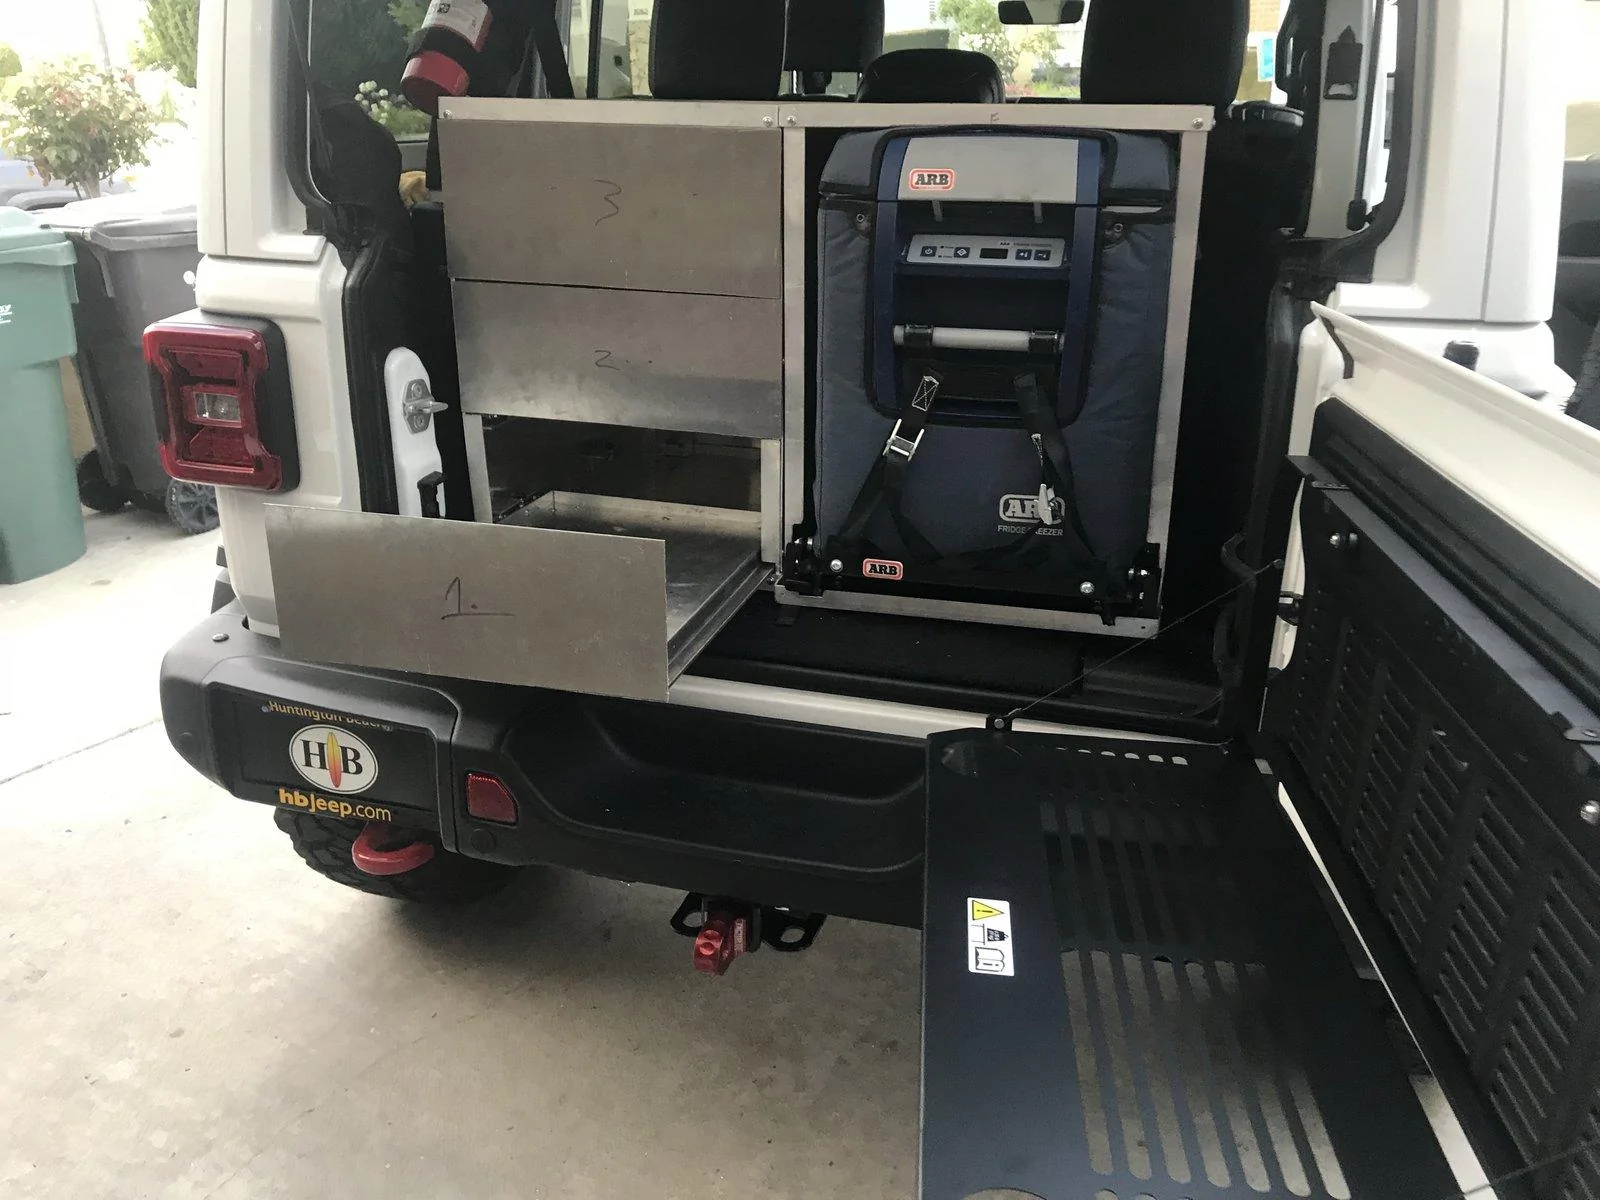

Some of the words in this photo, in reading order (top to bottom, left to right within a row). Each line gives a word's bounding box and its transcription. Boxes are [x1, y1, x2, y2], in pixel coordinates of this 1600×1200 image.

[915, 173, 949, 186] ARB
[594, 179, 622, 226] 3
[868, 563, 898, 576] ARB
[278, 788, 392, 822] hbjeep.com
